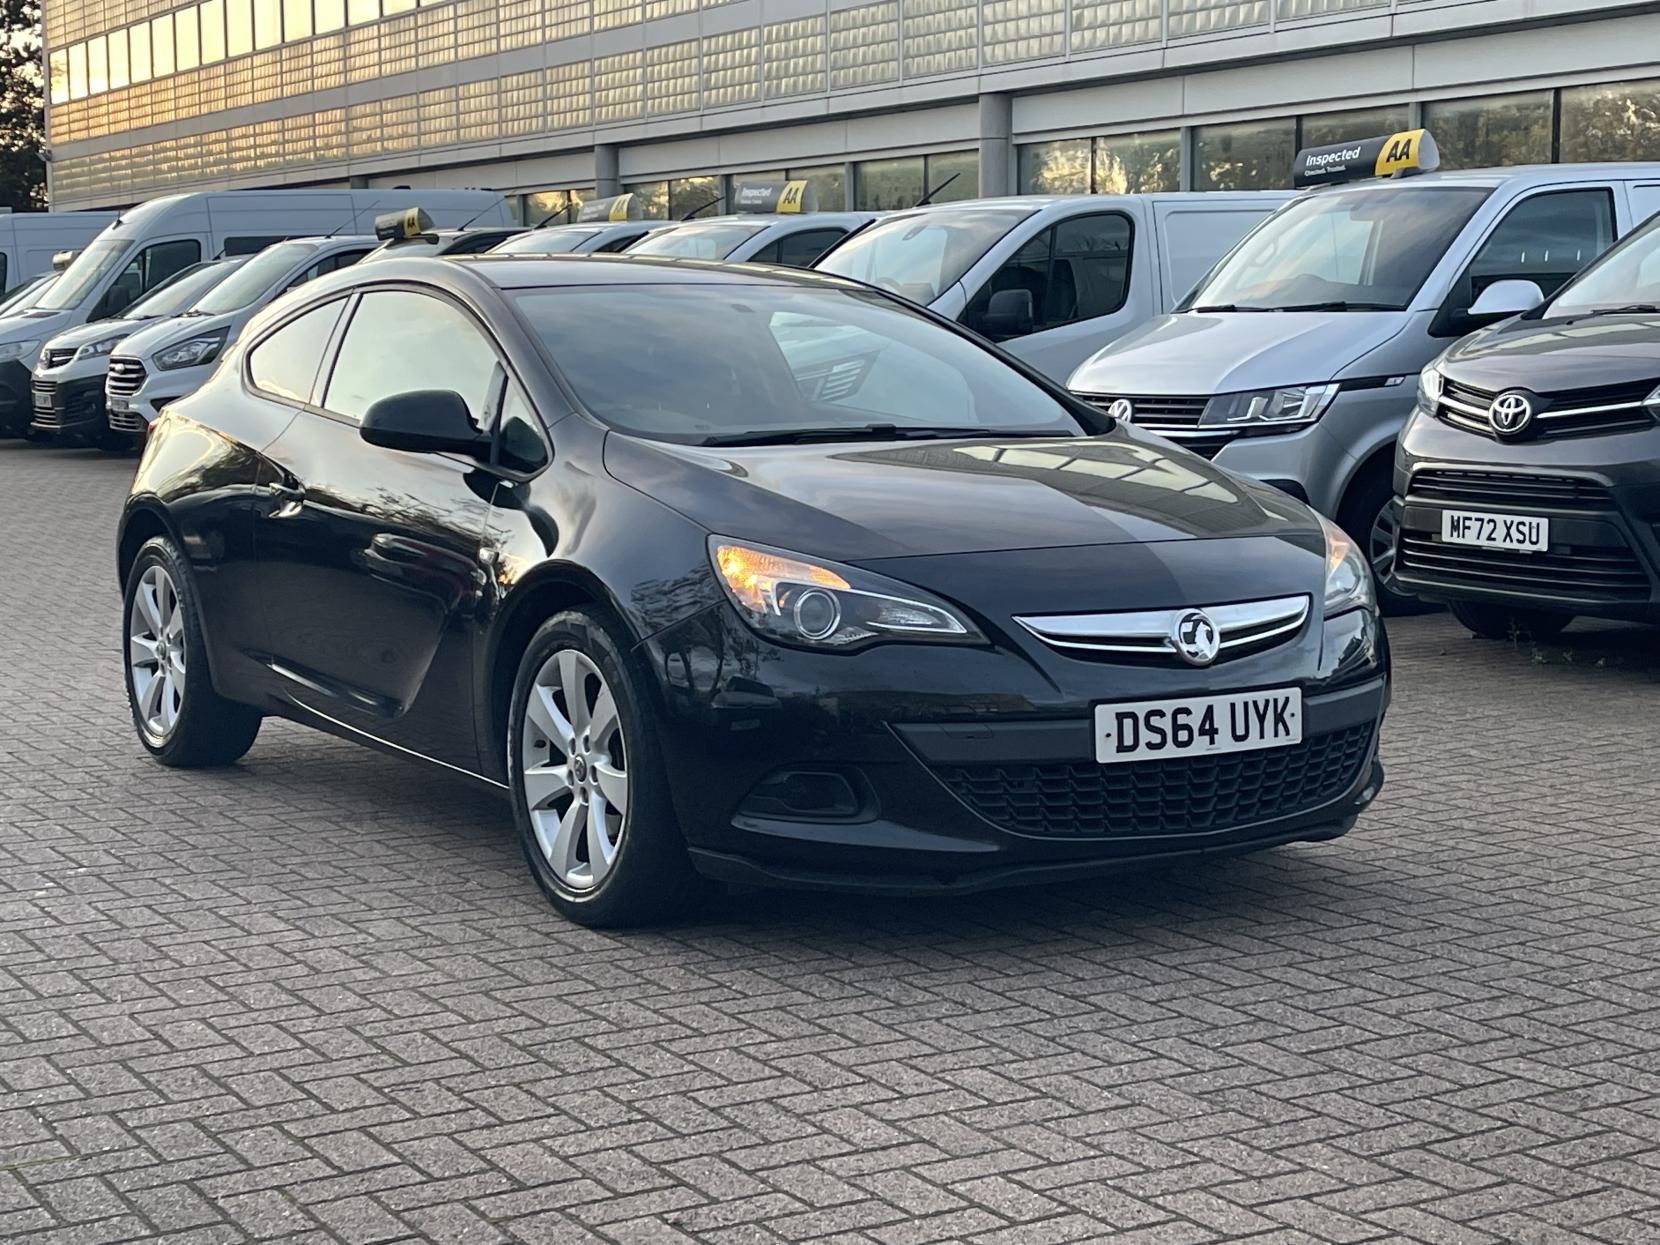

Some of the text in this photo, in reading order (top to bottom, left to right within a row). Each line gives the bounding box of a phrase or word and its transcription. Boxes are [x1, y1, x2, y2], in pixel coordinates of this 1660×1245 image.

[1306, 146, 1361, 167] Inspected
[1386, 138, 1412, 163] AA
[783, 187, 799, 204] AA
[1450, 515, 1540, 545] MF72 XSU
[1115, 696, 1290, 753] DS64 UYK
